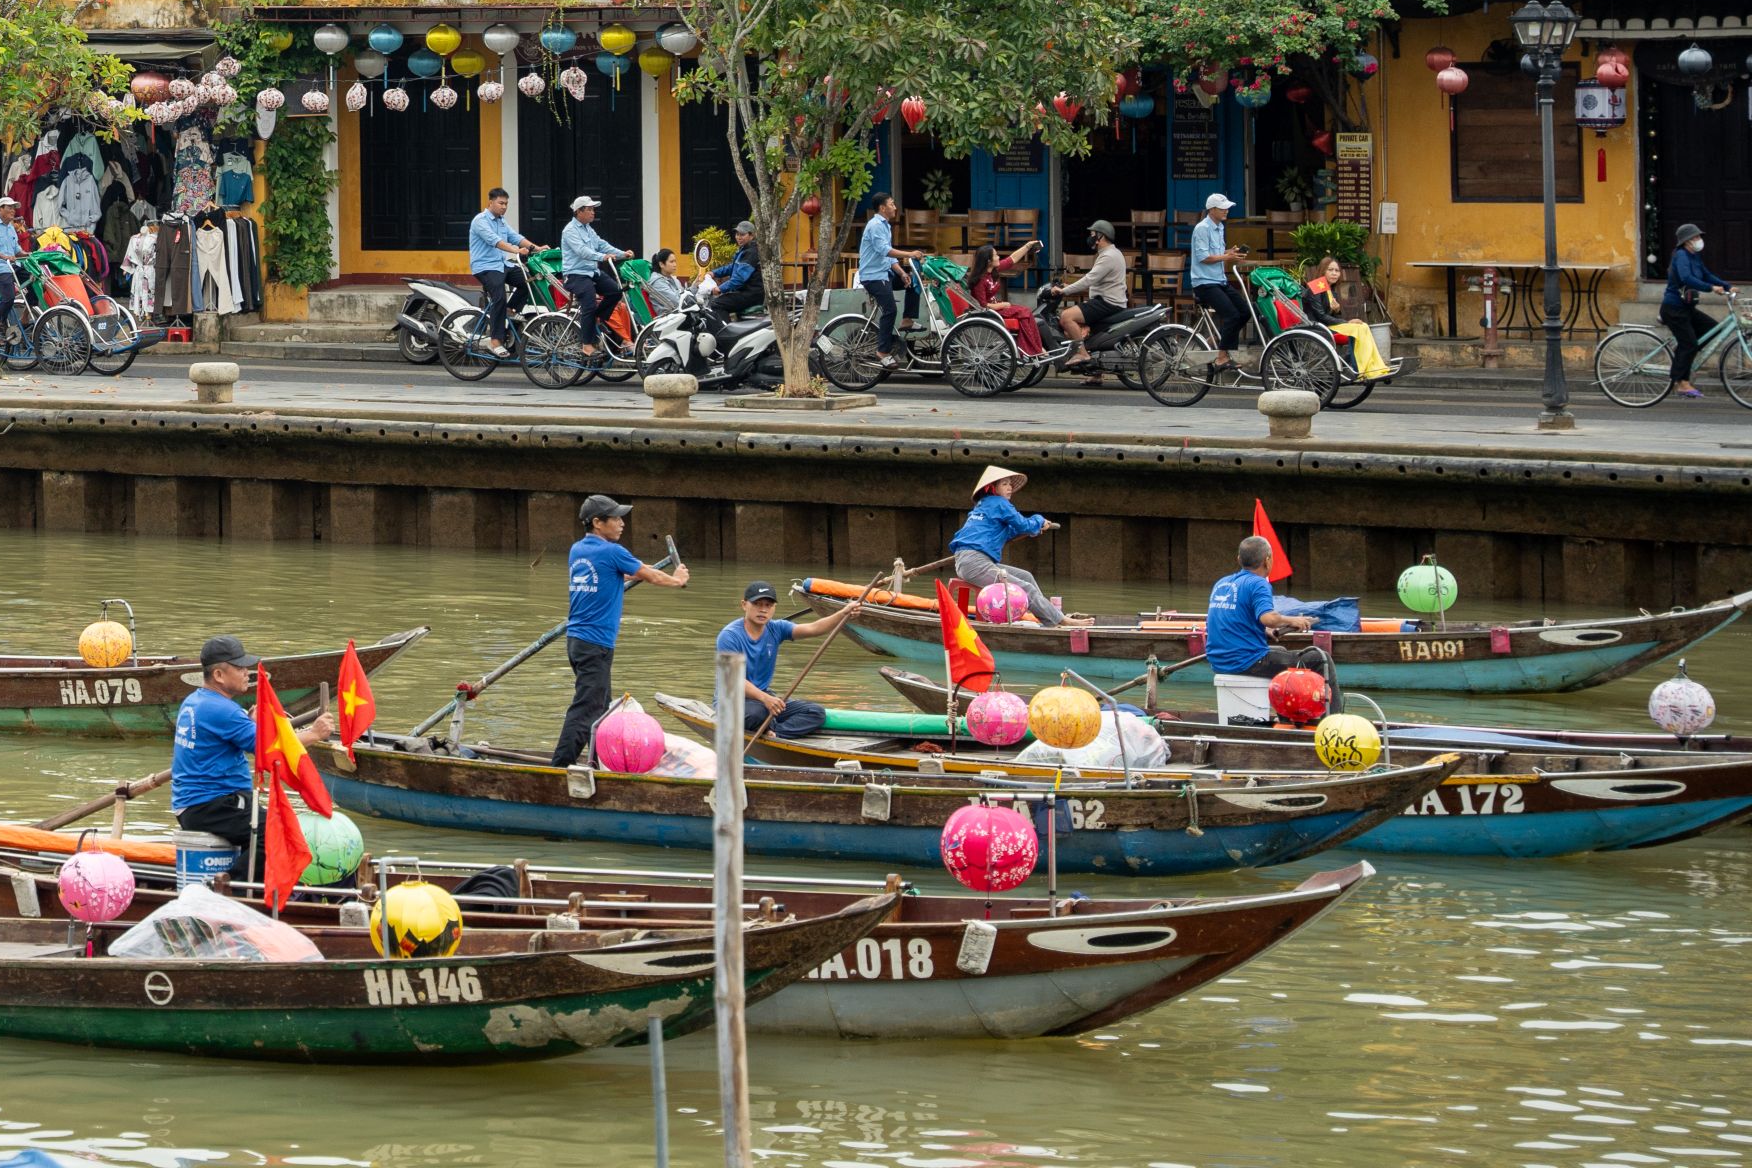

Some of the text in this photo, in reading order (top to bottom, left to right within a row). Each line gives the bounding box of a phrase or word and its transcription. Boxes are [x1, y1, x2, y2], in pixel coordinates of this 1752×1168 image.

[1399, 639, 1465, 661] HA091
[59, 678, 143, 704] HA.079
[801, 937, 934, 979] A.018
[363, 966, 484, 1005] HA.146
